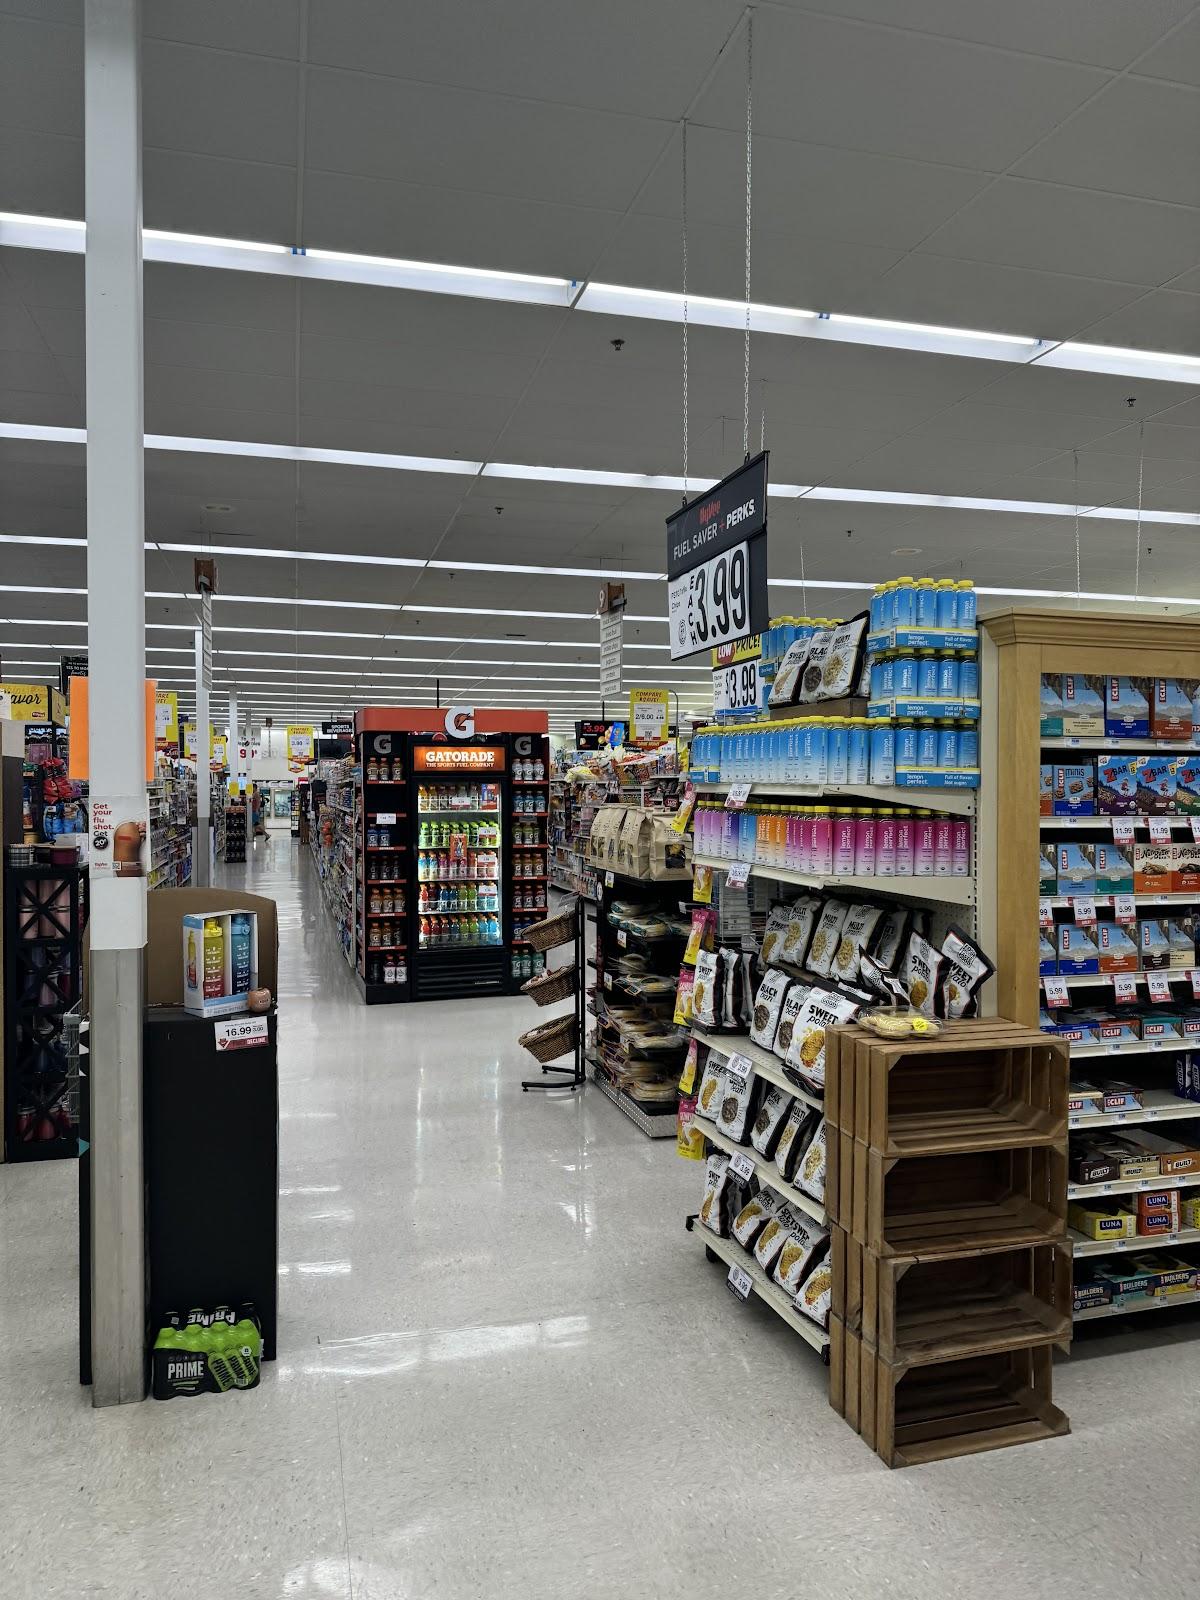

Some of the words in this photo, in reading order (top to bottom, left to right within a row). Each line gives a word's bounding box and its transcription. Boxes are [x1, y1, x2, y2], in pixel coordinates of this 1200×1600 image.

[673, 542, 692, 560] FUEL
[692, 523, 718, 550] SAVER
[726, 498, 755, 529] PERKS
[695, 549, 747, 642] 3.99
[717, 642, 733, 659] LOW
[373, 734, 391, 754] G
[514, 736, 532, 756] G
[425, 750, 495, 763] GATORADE
[1065, 768, 1085, 776] minis
[1115, 827, 1133, 835] 11.99
[1118, 905, 1132, 913] 5.99
[950, 960, 973, 984] WEET
[760, 983, 779, 997] BLACK
[1049, 987, 1063, 995] 5.99
[1118, 983, 1132, 991] 5.99
[786, 997, 803, 1011] BLAC
[809, 1004, 839, 1025] SWEET
[225, 1026, 252, 1036] 16.99
[1149, 1025, 1164, 1033] CLIF
[1189, 1024, 1200, 1032] CLI
[1066, 1032, 1082, 1040] CLIF
[1107, 1029, 1121, 1037] CLIF
[708, 1060, 722, 1073] SWEE
[1069, 1101, 1082, 1109] CLIF
[1110, 1098, 1125, 1106] CLIF
[1175, 1159, 1192, 1168] BUILT
[1101, 1220, 1121, 1228] LUNA
[1149, 1216, 1167, 1224] LUNA
[1164, 1273, 1190, 1283] BUILDERS
[1124, 1280, 1148, 1290] BUILDERS
[1078, 1287, 1104, 1296] BUILDERS
[167, 1360, 204, 1379] PRIME
